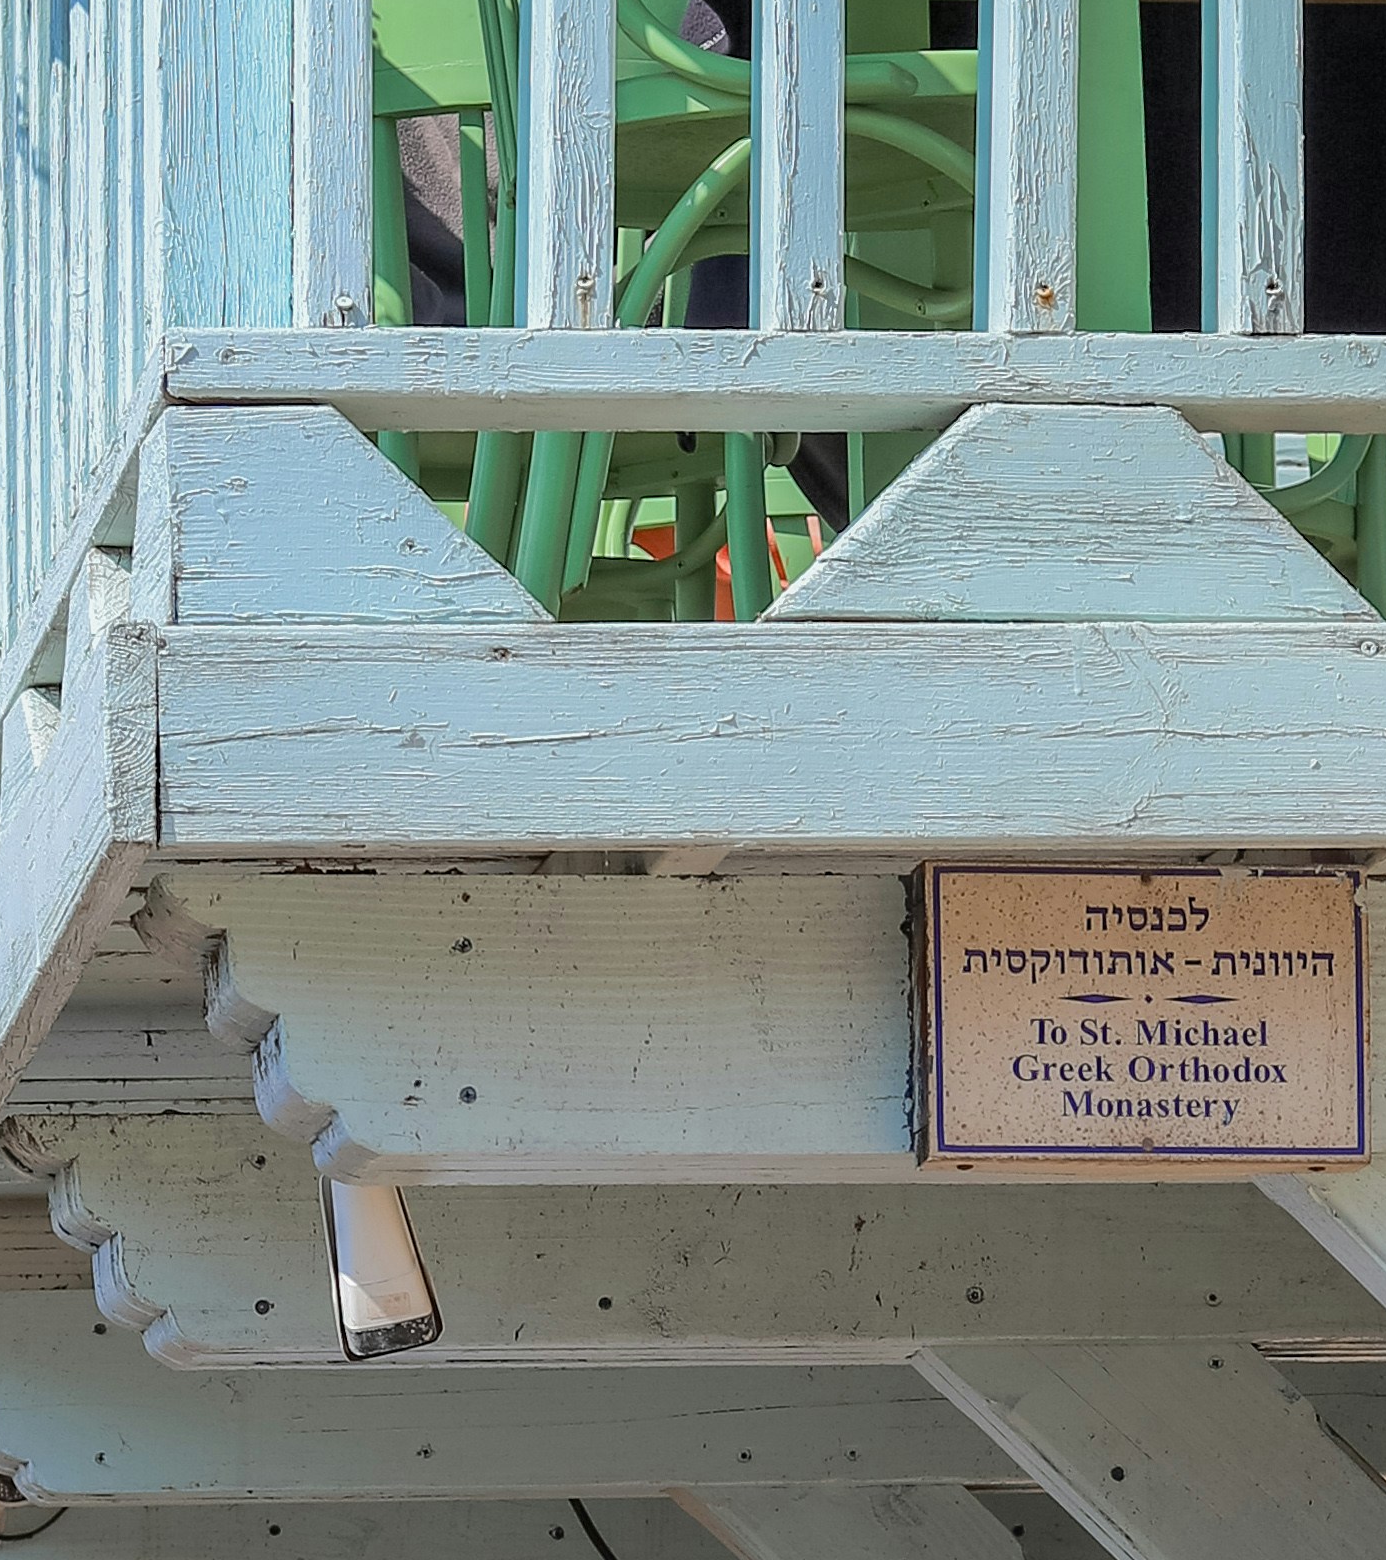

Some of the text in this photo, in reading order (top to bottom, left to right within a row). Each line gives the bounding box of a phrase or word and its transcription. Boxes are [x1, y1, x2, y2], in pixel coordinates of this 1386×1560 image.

[1085, 896, 1210, 932] לכנסיה
[962, 947, 1175, 984] אותודוקסית
[1211, 949, 1334, 977] היוונית
[1030, 1018, 1269, 1047] To St. Michael
[1012, 1054, 1288, 1083] Greek Orthodox
[1062, 1090, 1241, 1126] Monastery
